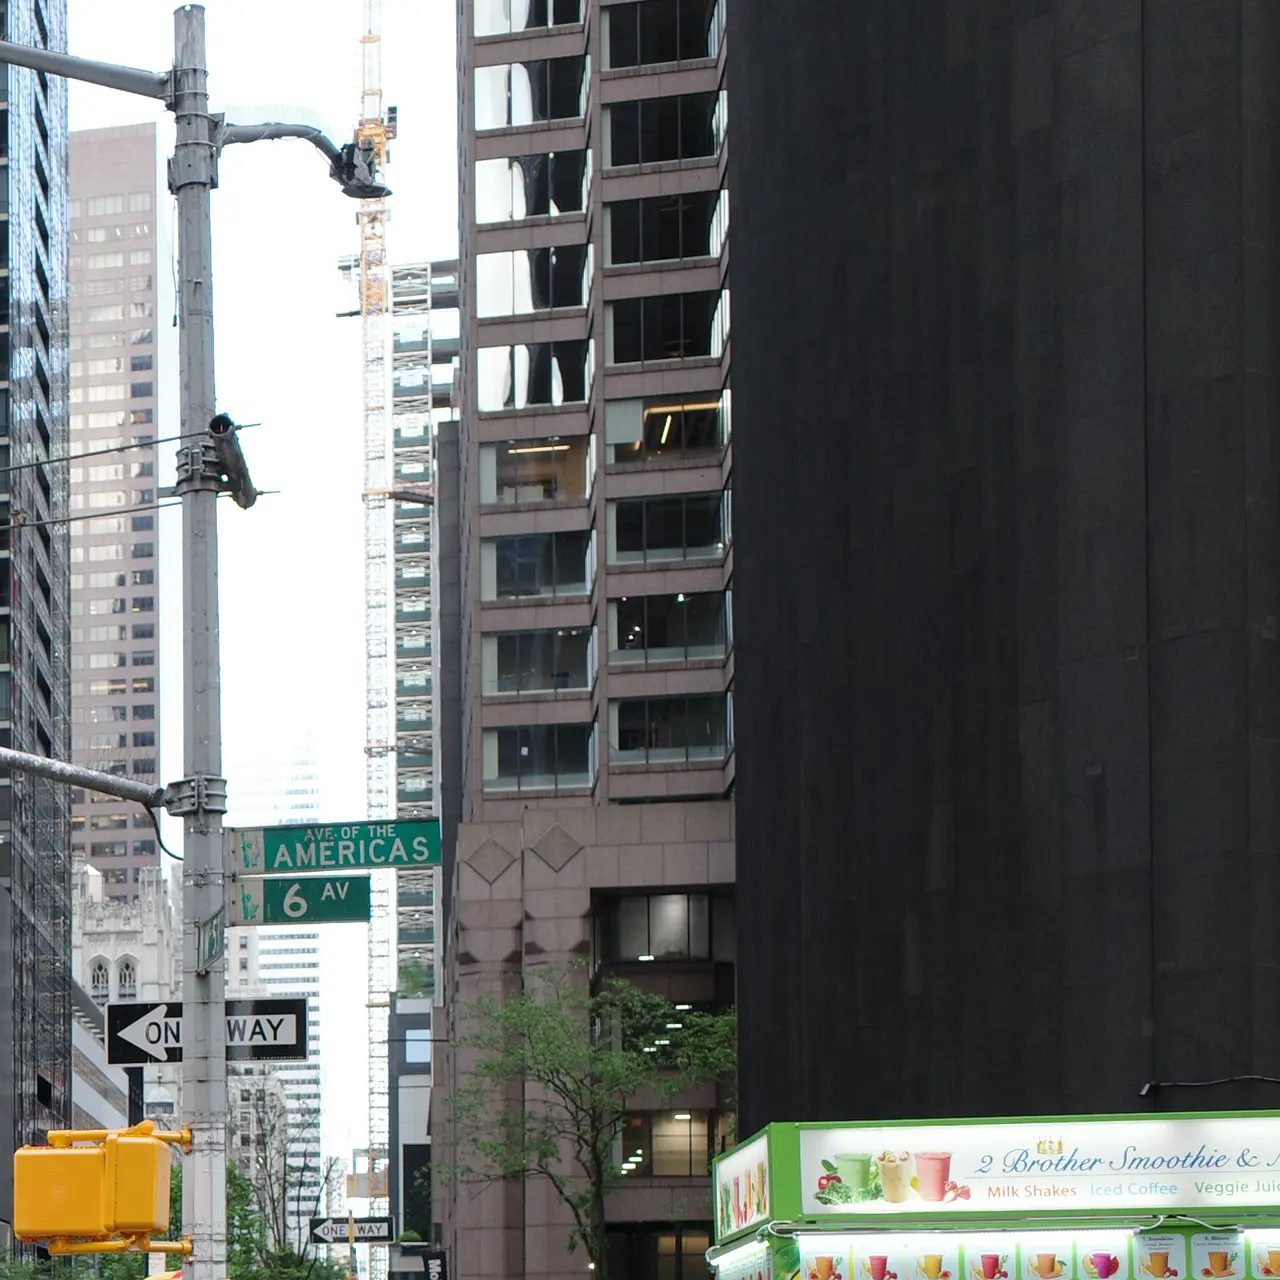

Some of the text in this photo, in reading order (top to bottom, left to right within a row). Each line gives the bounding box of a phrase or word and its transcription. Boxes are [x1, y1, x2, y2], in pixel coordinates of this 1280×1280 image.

[341, 826, 360, 839] OF
[368, 823, 396, 838] THE
[273, 836, 429, 868] AMERICAS
[283, 881, 350, 918] 6 AV
[145, 1018, 284, 1045] ON WAY
[974, 1144, 1260, 1174] 2 Brother Smoothie &
[988, 1185, 1019, 1199] Milk
[1024, 1184, 1077, 1198] Shakes
[1090, 1183, 1123, 1196] Iced
[1127, 1182, 1178, 1196] Coffee
[1194, 1180, 1249, 1197] Veggie
[322, 1224, 382, 1236] ONE WAY
